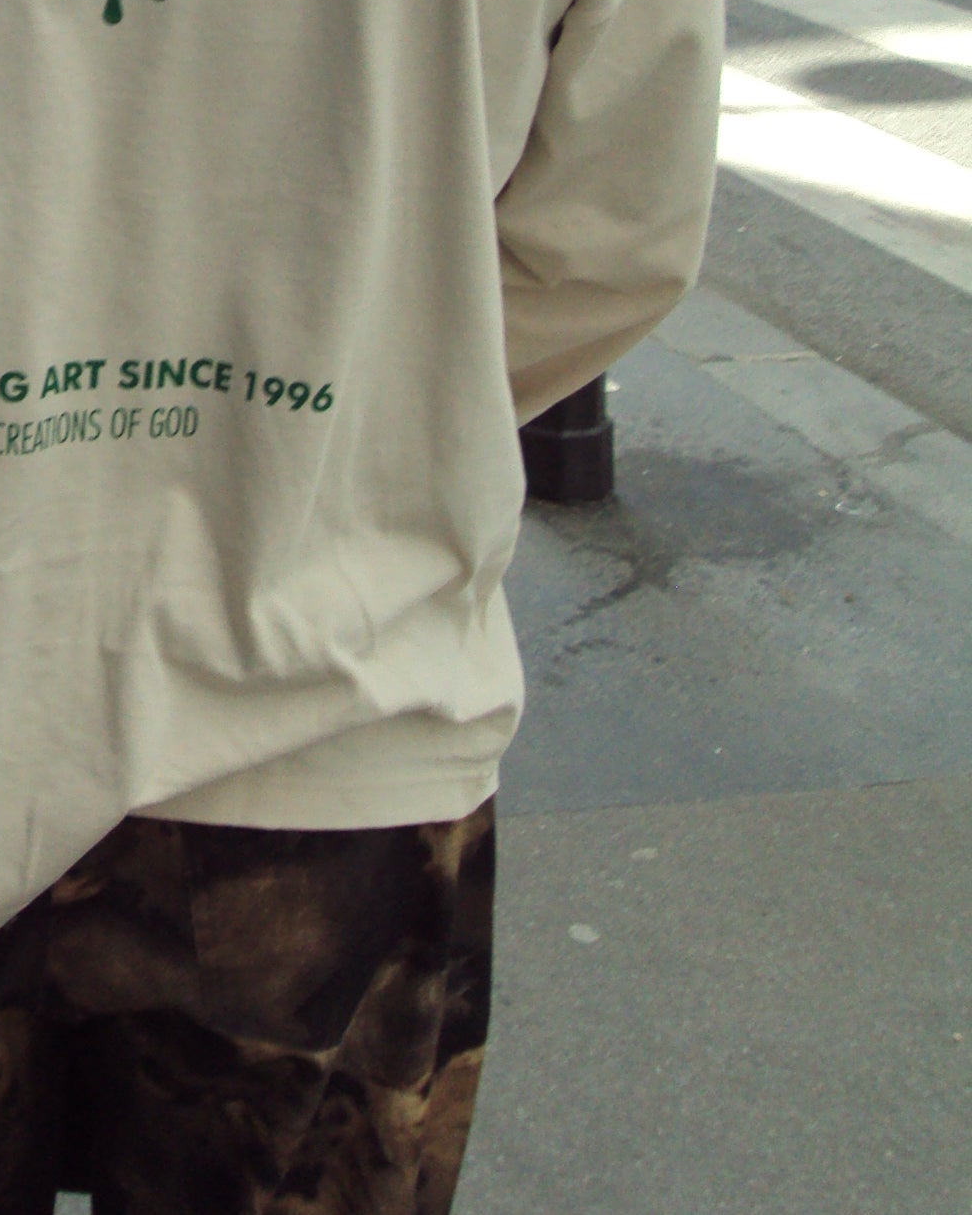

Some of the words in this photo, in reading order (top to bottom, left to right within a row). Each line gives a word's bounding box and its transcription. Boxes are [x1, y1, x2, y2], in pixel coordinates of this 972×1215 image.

[40, 359, 107, 399] ART
[118, 357, 234, 393] SINCE
[243, 371, 335, 413] 1996
[109, 406, 142, 441] OF
[149, 405, 200, 439] GOD
